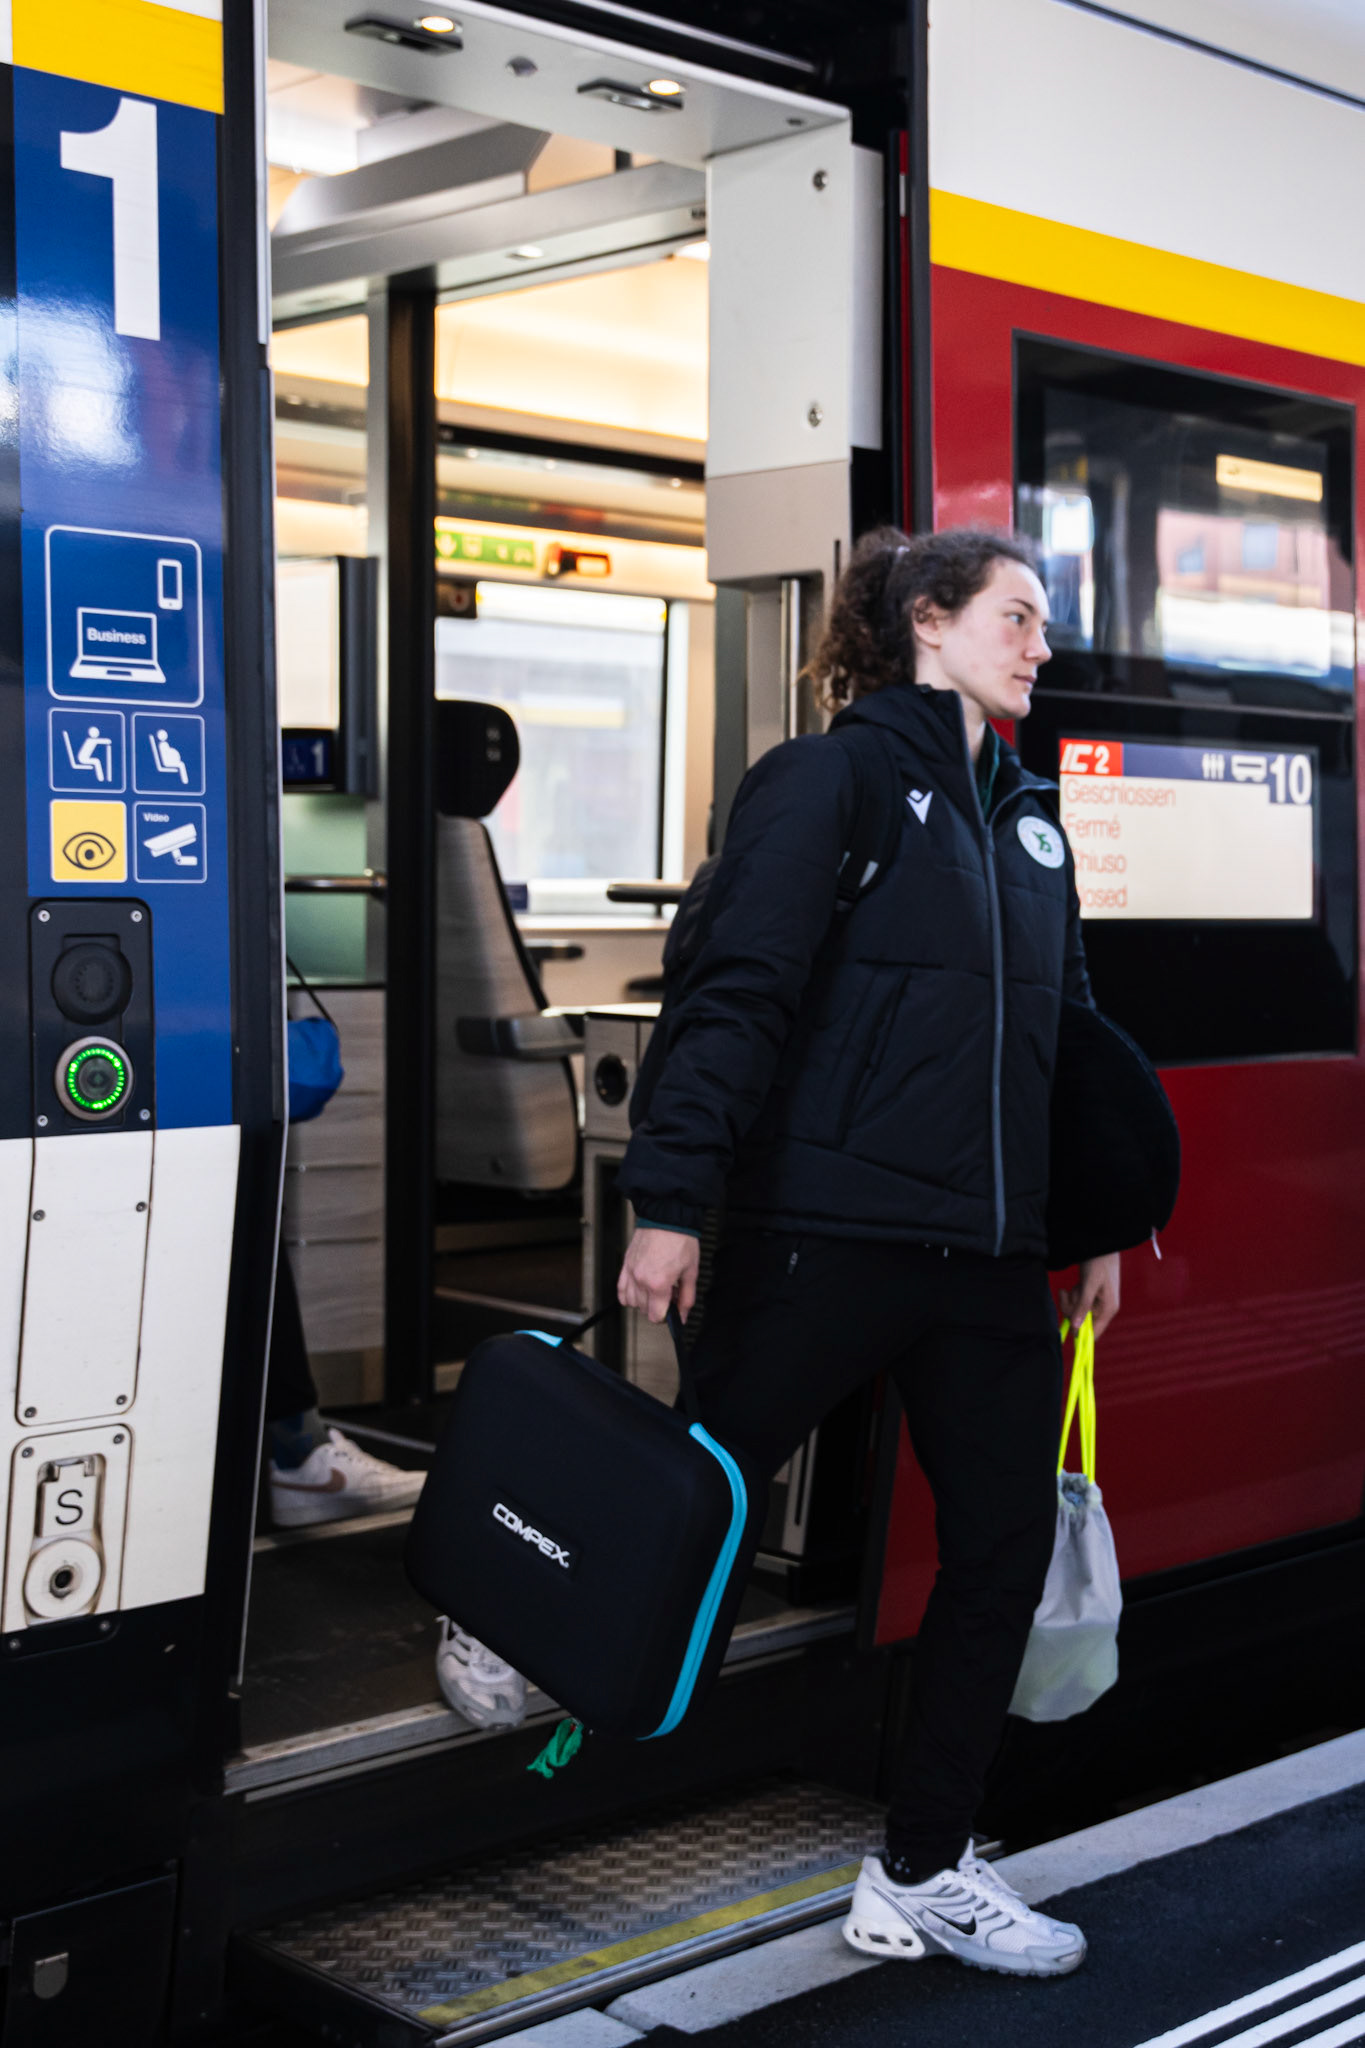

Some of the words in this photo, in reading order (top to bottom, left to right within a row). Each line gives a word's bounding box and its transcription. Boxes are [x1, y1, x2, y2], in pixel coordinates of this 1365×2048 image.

[60, 97, 160, 340] 1
[87, 628, 146, 645] Business
[1065, 779, 1175, 806] Geschlossen
[1270, 754, 1312, 804] 10
[143, 812, 170, 822] Video
[1065, 812, 1121, 840] Fermé
[1077, 885, 1127, 908] losed
[55, 1489, 83, 1524] S
